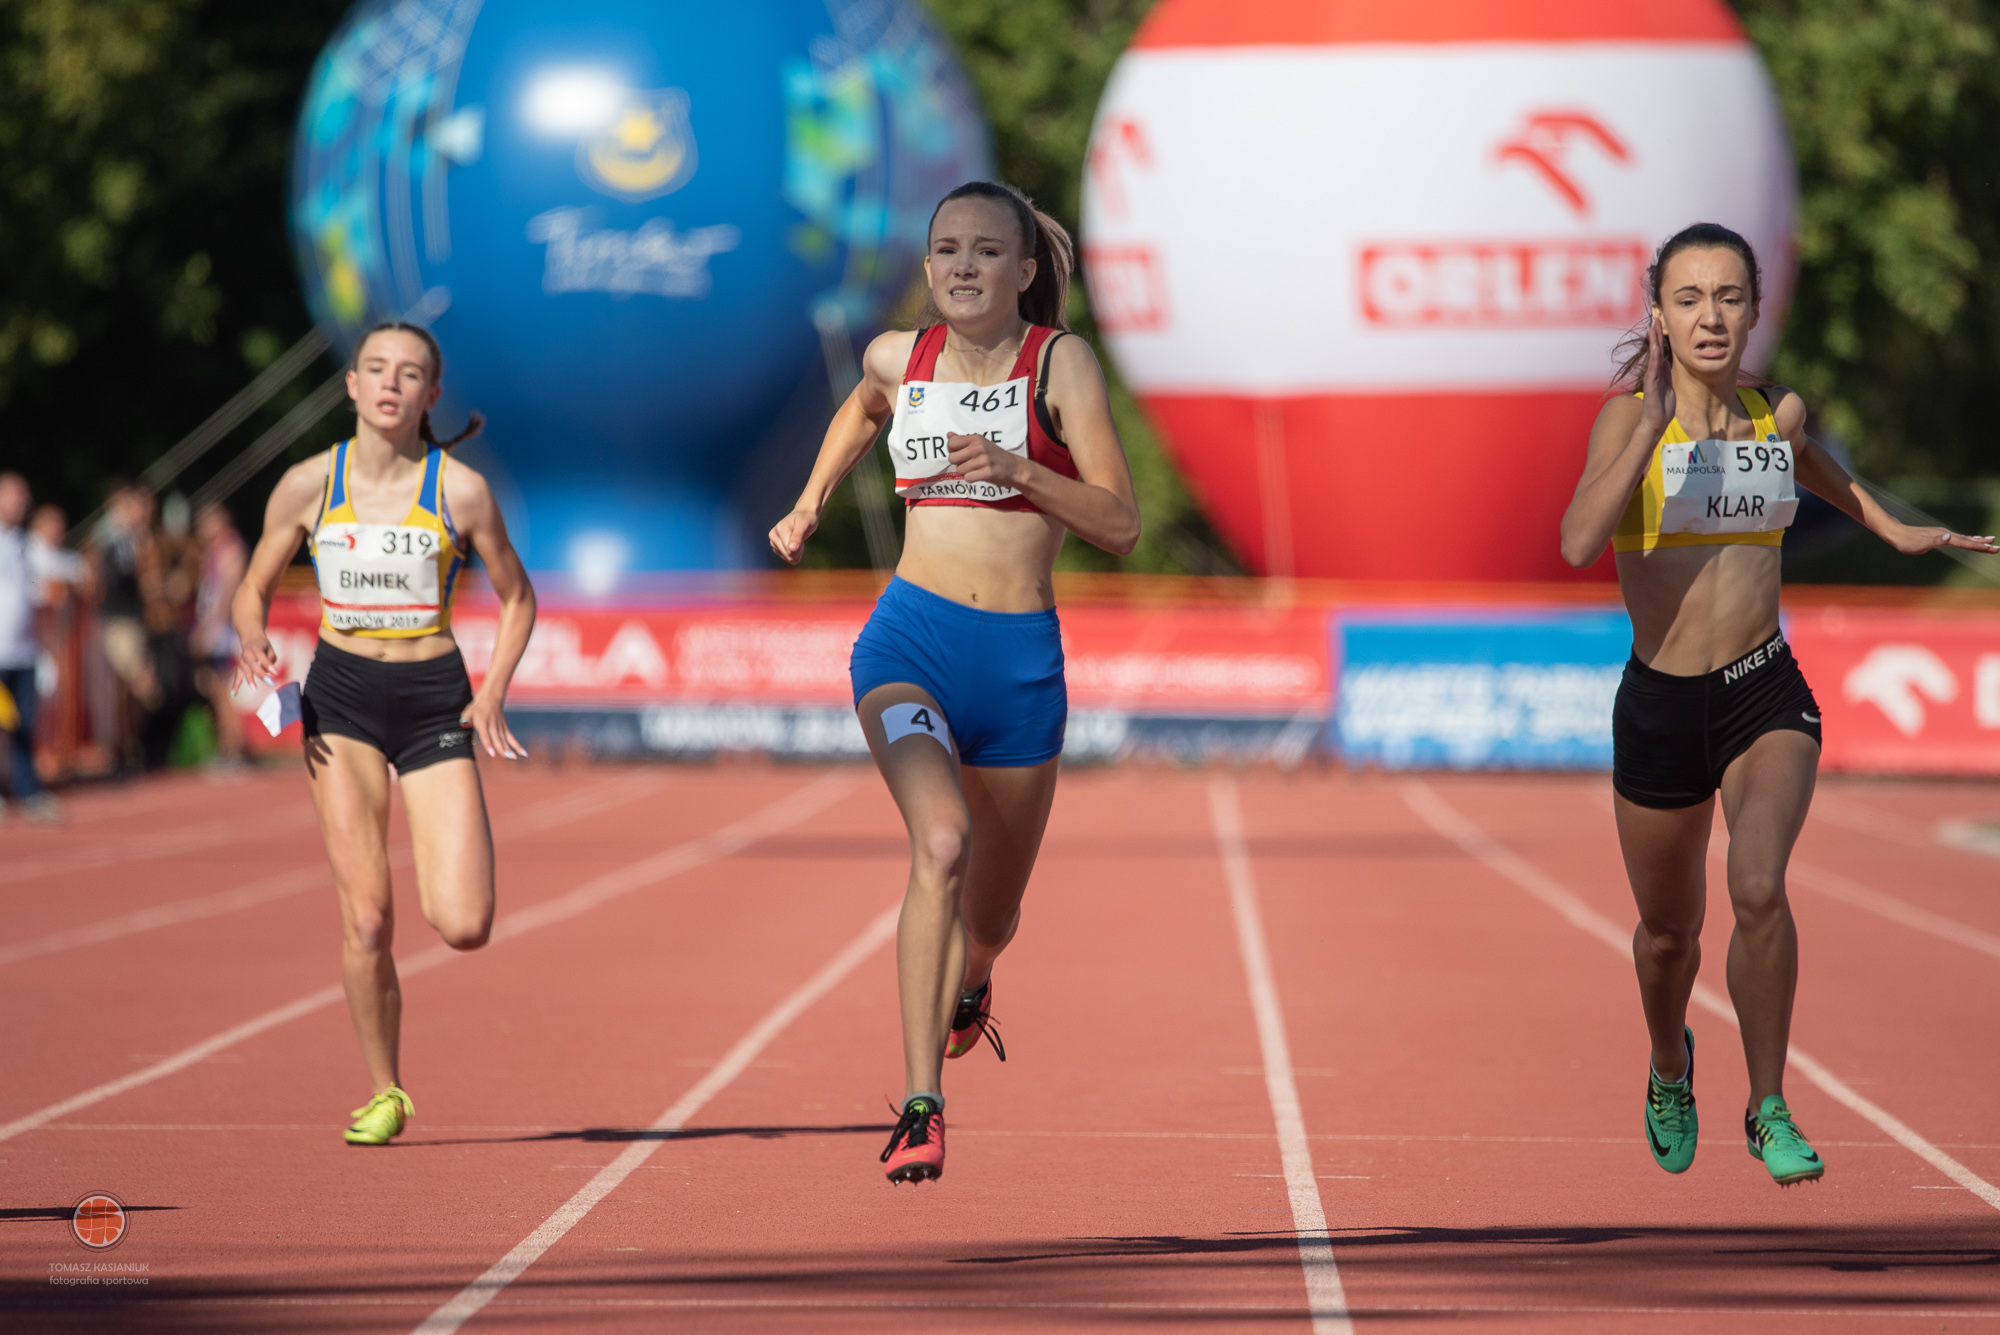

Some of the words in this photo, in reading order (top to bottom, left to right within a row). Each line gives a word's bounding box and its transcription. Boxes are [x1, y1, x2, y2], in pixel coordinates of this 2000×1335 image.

[1366, 247, 1636, 314] ORLEN
[959, 385, 1019, 412] 461
[1666, 466, 1726, 475] MAŁOPOLSKA
[1735, 446, 1789, 473] 593
[919, 480, 977, 497] TARNÓW
[1706, 495, 1765, 518] KLAR
[382, 531, 432, 555] 319
[340, 570, 410, 591] BINIEK
[332, 611, 384, 628] TARNÓW
[390, 615, 420, 628] 2019
[1723, 649, 1766, 685] NIKE
[910, 708, 935, 733] 4
